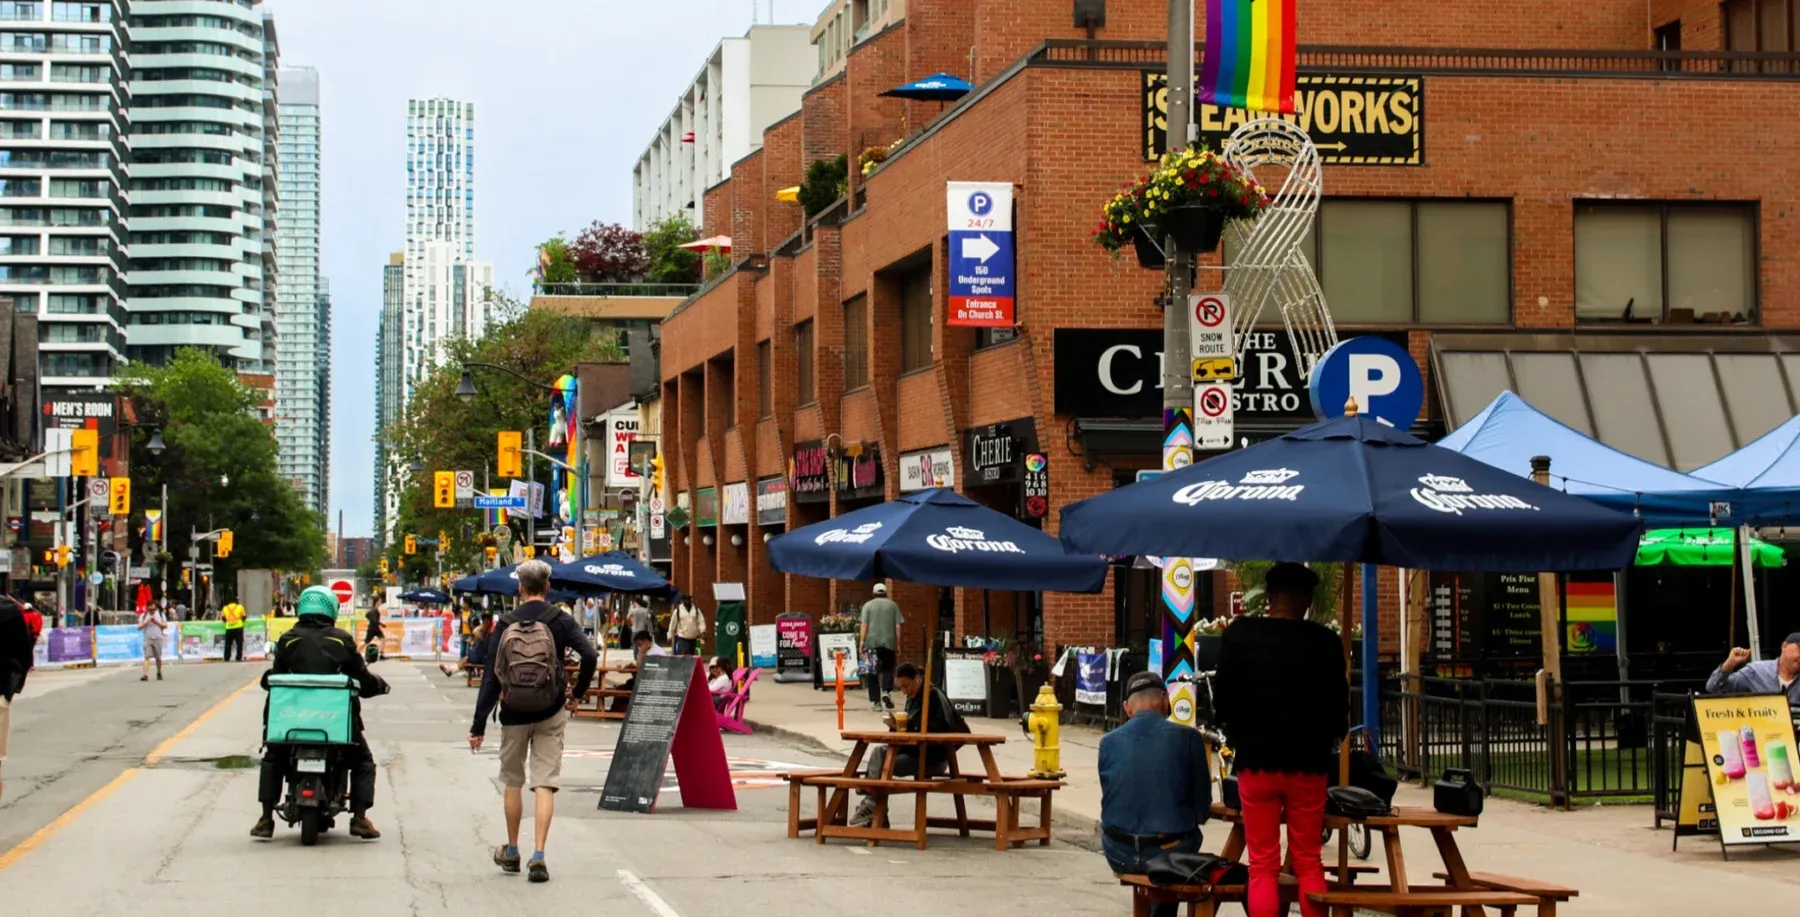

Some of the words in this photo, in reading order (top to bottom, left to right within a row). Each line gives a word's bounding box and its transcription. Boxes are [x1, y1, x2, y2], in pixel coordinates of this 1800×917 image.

[967, 218, 995, 229] 24/7
[974, 265, 989, 275] 150
[958, 275, 1005, 286] Underground
[971, 285, 992, 294] Spots
[965, 298, 997, 309] Entrance
[957, 309, 967, 319] On
[968, 309, 995, 320] Church
[995, 310, 1005, 320] St.
[1200, 332, 1223, 343] SNOW
[1199, 345, 1225, 354] ROUTE
[1348, 353, 1402, 414] P
[1231, 391, 1299, 413] STRO
[52, 401, 83, 417] MEN'S
[84, 402, 112, 417] ROOM
[615, 443, 625, 454] A
[972, 434, 1012, 472] CHERIE
[920, 454, 935, 488] BR
[983, 466, 1000, 481] BISTRO
[1172, 480, 1305, 507] Corona
[478, 496, 513, 506] Maitland
[584, 563, 635, 577] Corona
[1501, 575, 1517, 583] Prix
[1519, 575, 1536, 583] Fixe
[1507, 585, 1530, 594] Menu
[1510, 611, 1531, 619] Lunch
[782, 631, 798, 640] COME
[779, 639, 791, 649] FOR
[1705, 708, 1734, 719] Fresh
[1735, 708, 1746, 718] &
[1747, 706, 1779, 719] Fruity
